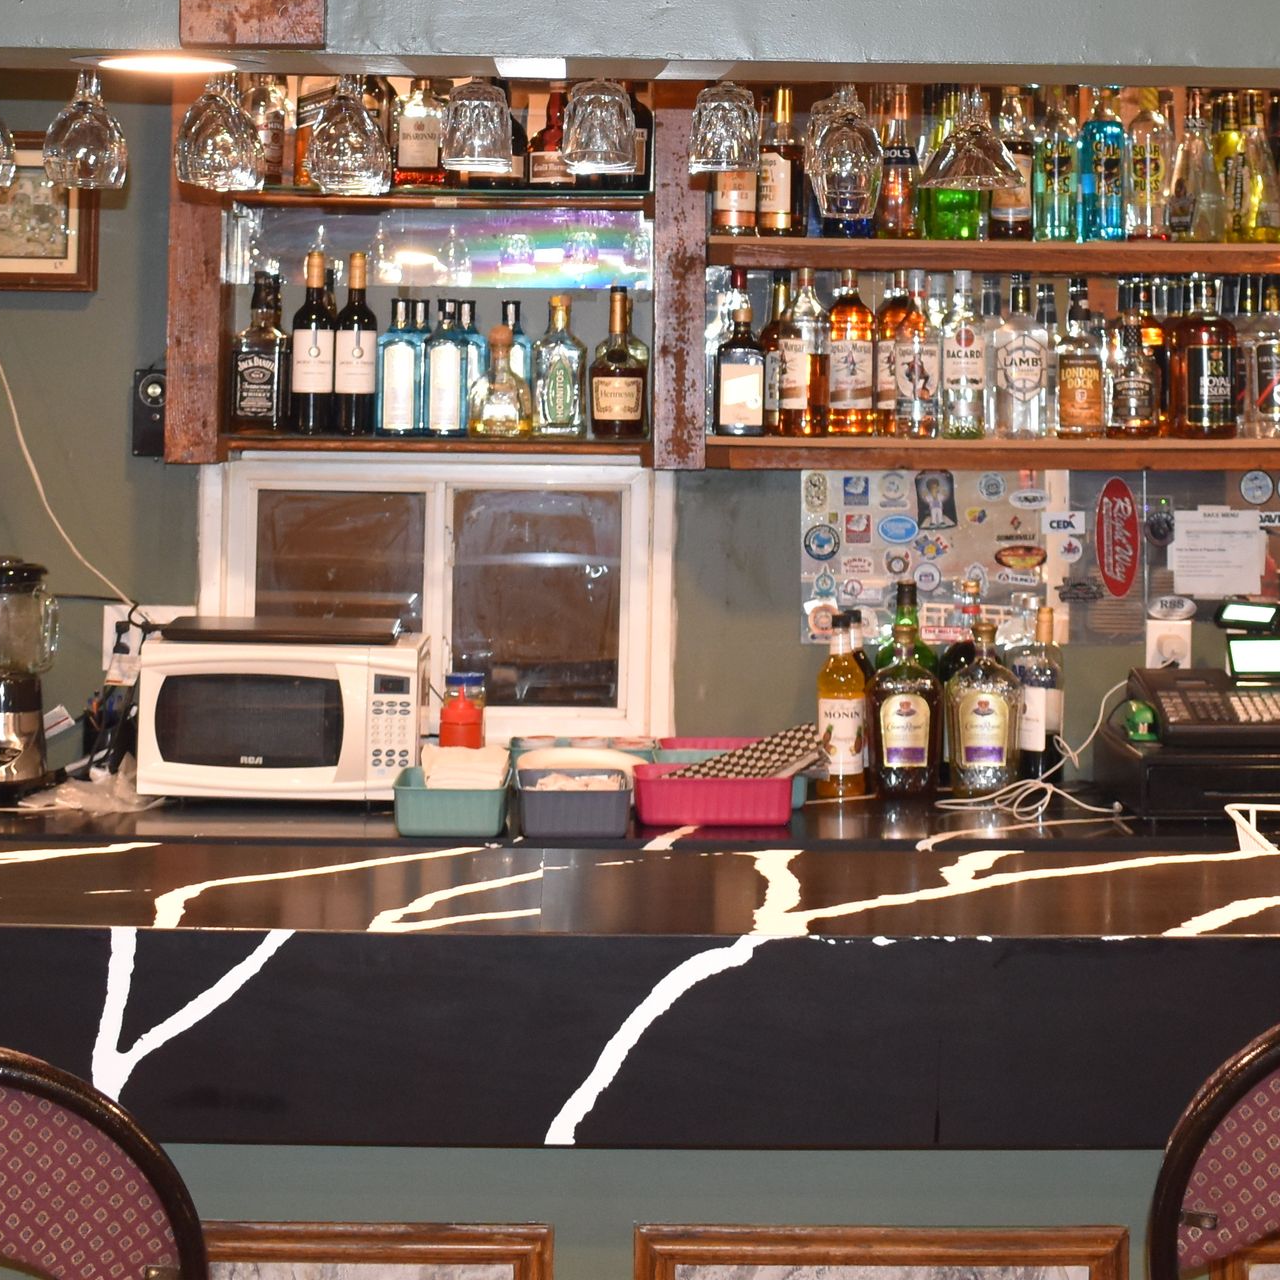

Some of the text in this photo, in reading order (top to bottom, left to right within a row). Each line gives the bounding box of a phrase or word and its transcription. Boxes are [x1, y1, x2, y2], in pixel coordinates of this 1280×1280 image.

[1061, 366, 1100, 381] LONDON
[1067, 378, 1094, 389] DOCK
[556, 369, 565, 419] HORNITOS
[600, 389, 636, 400] Hennessy
[1049, 519, 1076, 530] CEDA
[824, 711, 860, 719] MONIN
[240, 756, 263, 765] RCA
